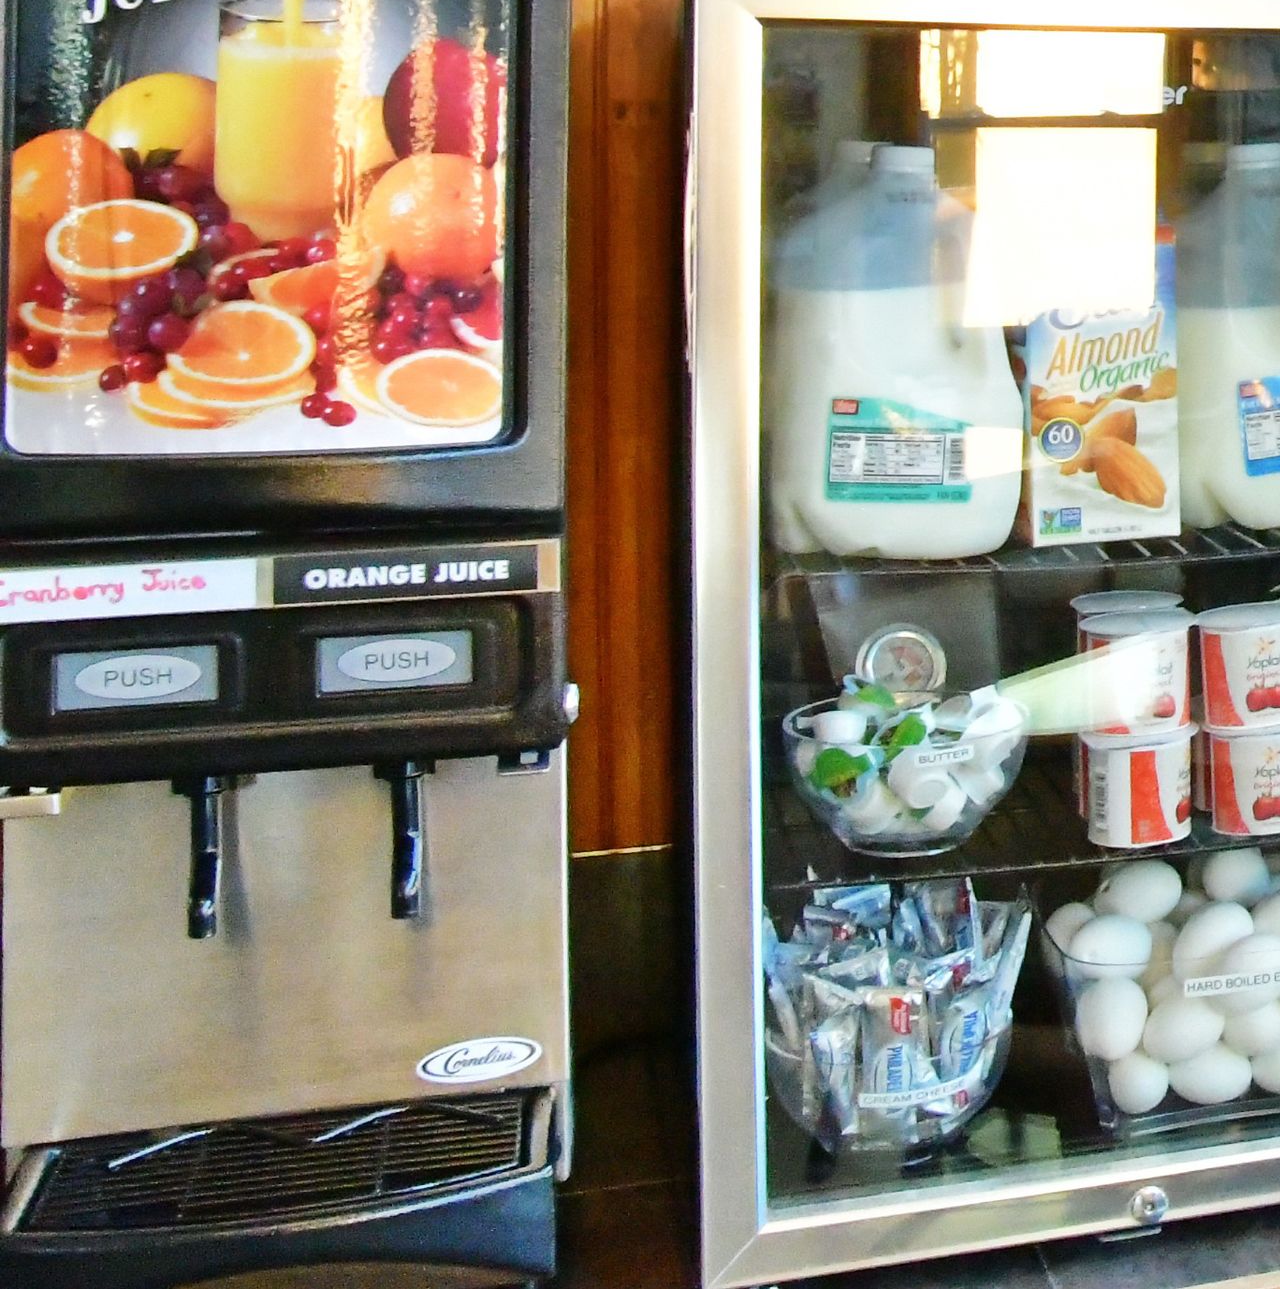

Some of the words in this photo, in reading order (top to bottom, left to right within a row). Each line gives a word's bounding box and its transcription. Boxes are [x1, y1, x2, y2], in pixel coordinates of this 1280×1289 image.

[1046, 310, 1164, 380] Almond
[1079, 351, 1169, 393] Organic
[1048, 424, 1075, 445] 60
[304, 563, 427, 591] ORANGE
[433, 559, 511, 585] JUICE
[364, 650, 430, 671] PUSH
[103, 667, 174, 689] PUSH
[918, 748, 969, 764] BUTTER
[1187, 978, 1223, 993] HARD
[1225, 972, 1272, 989] BOILED
[444, 1045, 517, 1074] Cornelius
